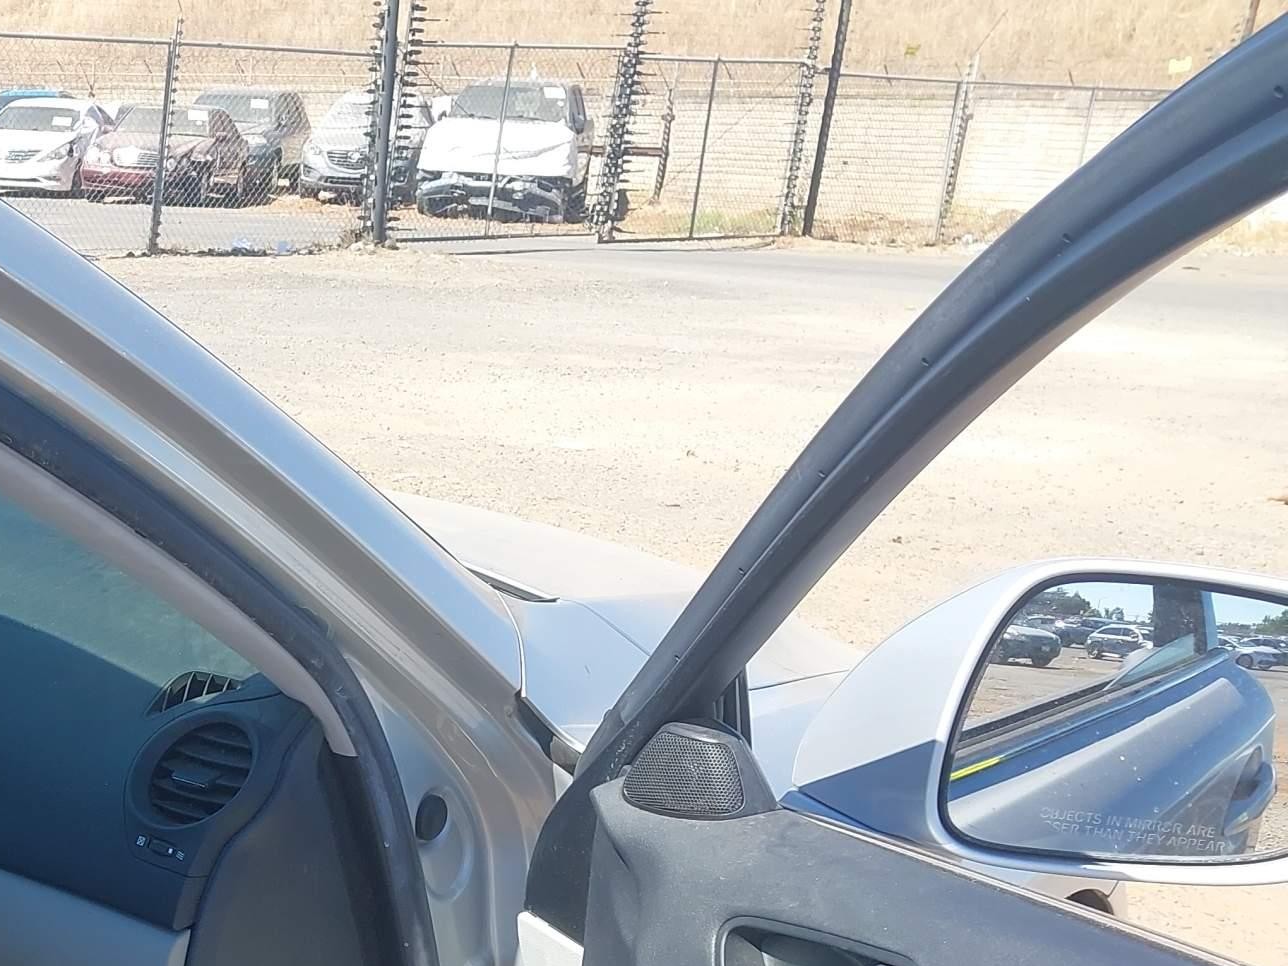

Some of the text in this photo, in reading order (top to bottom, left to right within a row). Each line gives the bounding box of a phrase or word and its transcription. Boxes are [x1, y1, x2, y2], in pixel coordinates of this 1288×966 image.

[1039, 807, 1216, 839] OBJECTS IN MIRROR ARE
[1085, 826, 1121, 841] THAN
[1126, 830, 1167, 846] THEY
[1167, 836, 1226, 852] APPEAR
